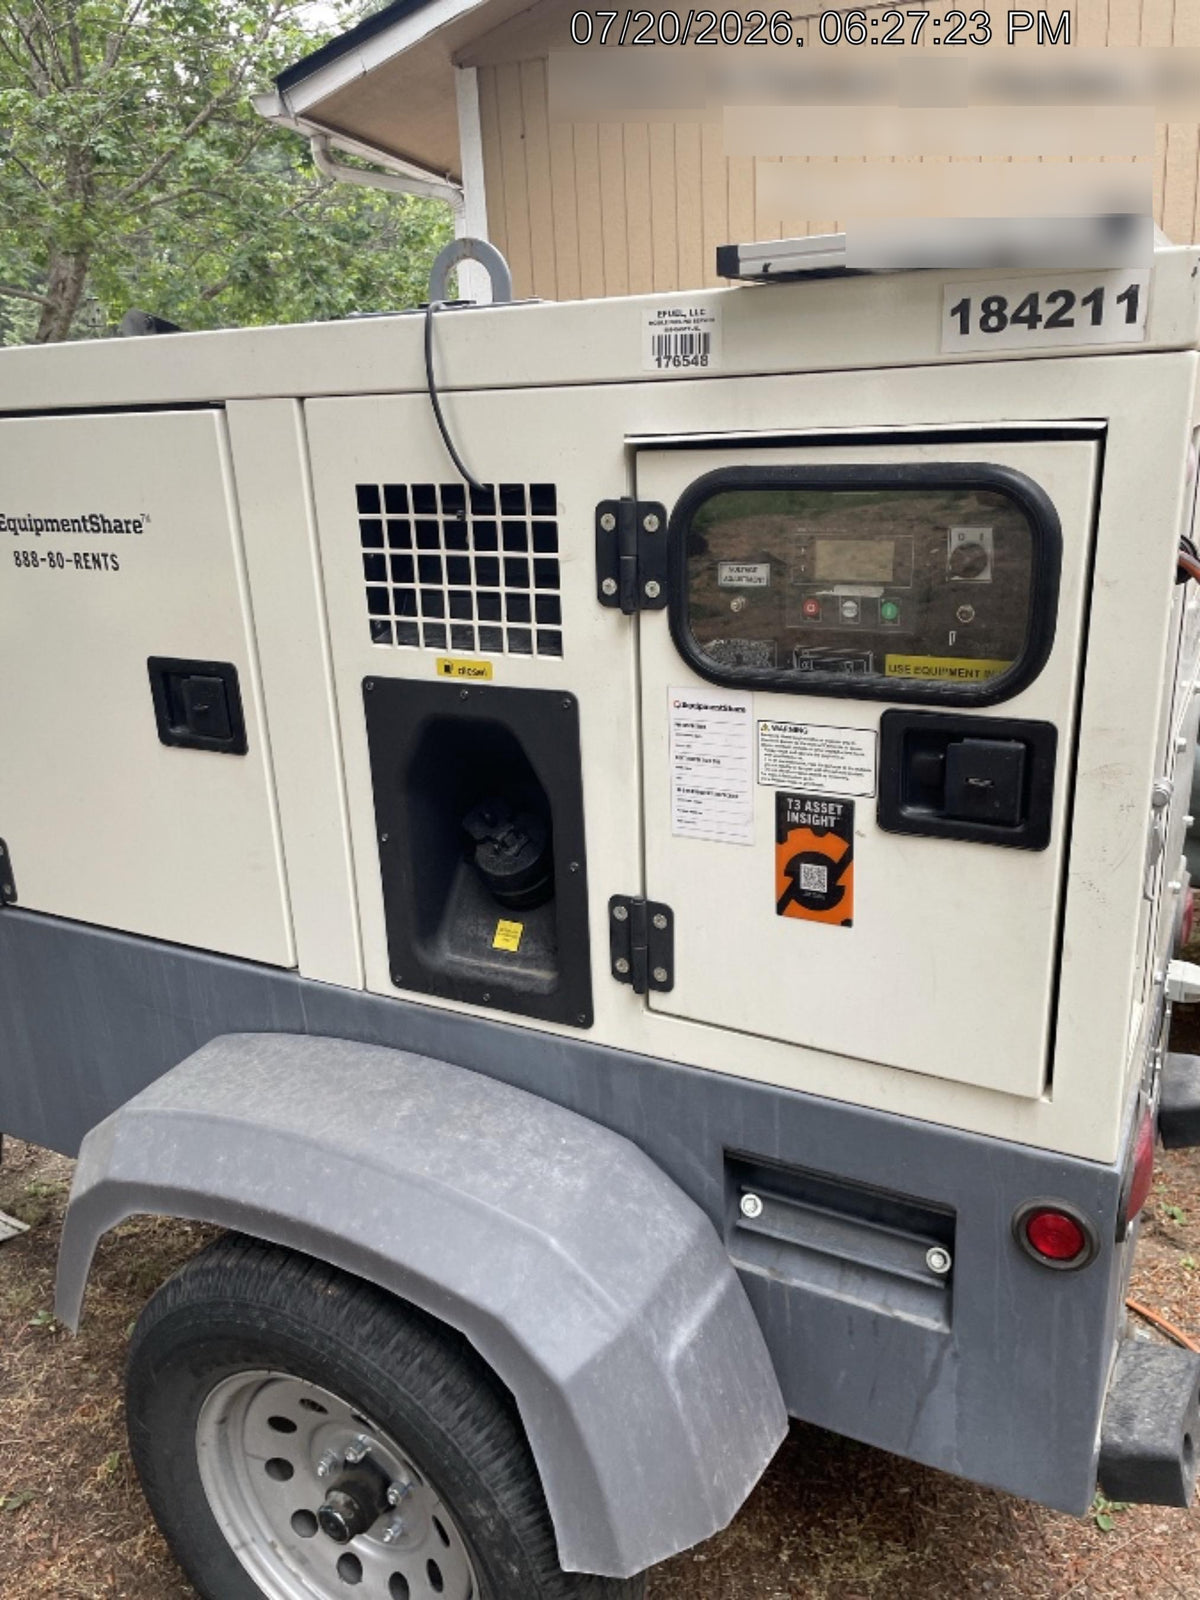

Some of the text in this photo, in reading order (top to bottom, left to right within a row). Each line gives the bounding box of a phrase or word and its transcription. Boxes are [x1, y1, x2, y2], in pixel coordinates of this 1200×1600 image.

[950, 284, 1140, 335] 184211
[655, 355, 709, 369] 176548
[13, 550, 120, 571] 888-80-RENTS
[888, 664, 911, 675] USE
[787, 798, 844, 815] T3 ASSET
